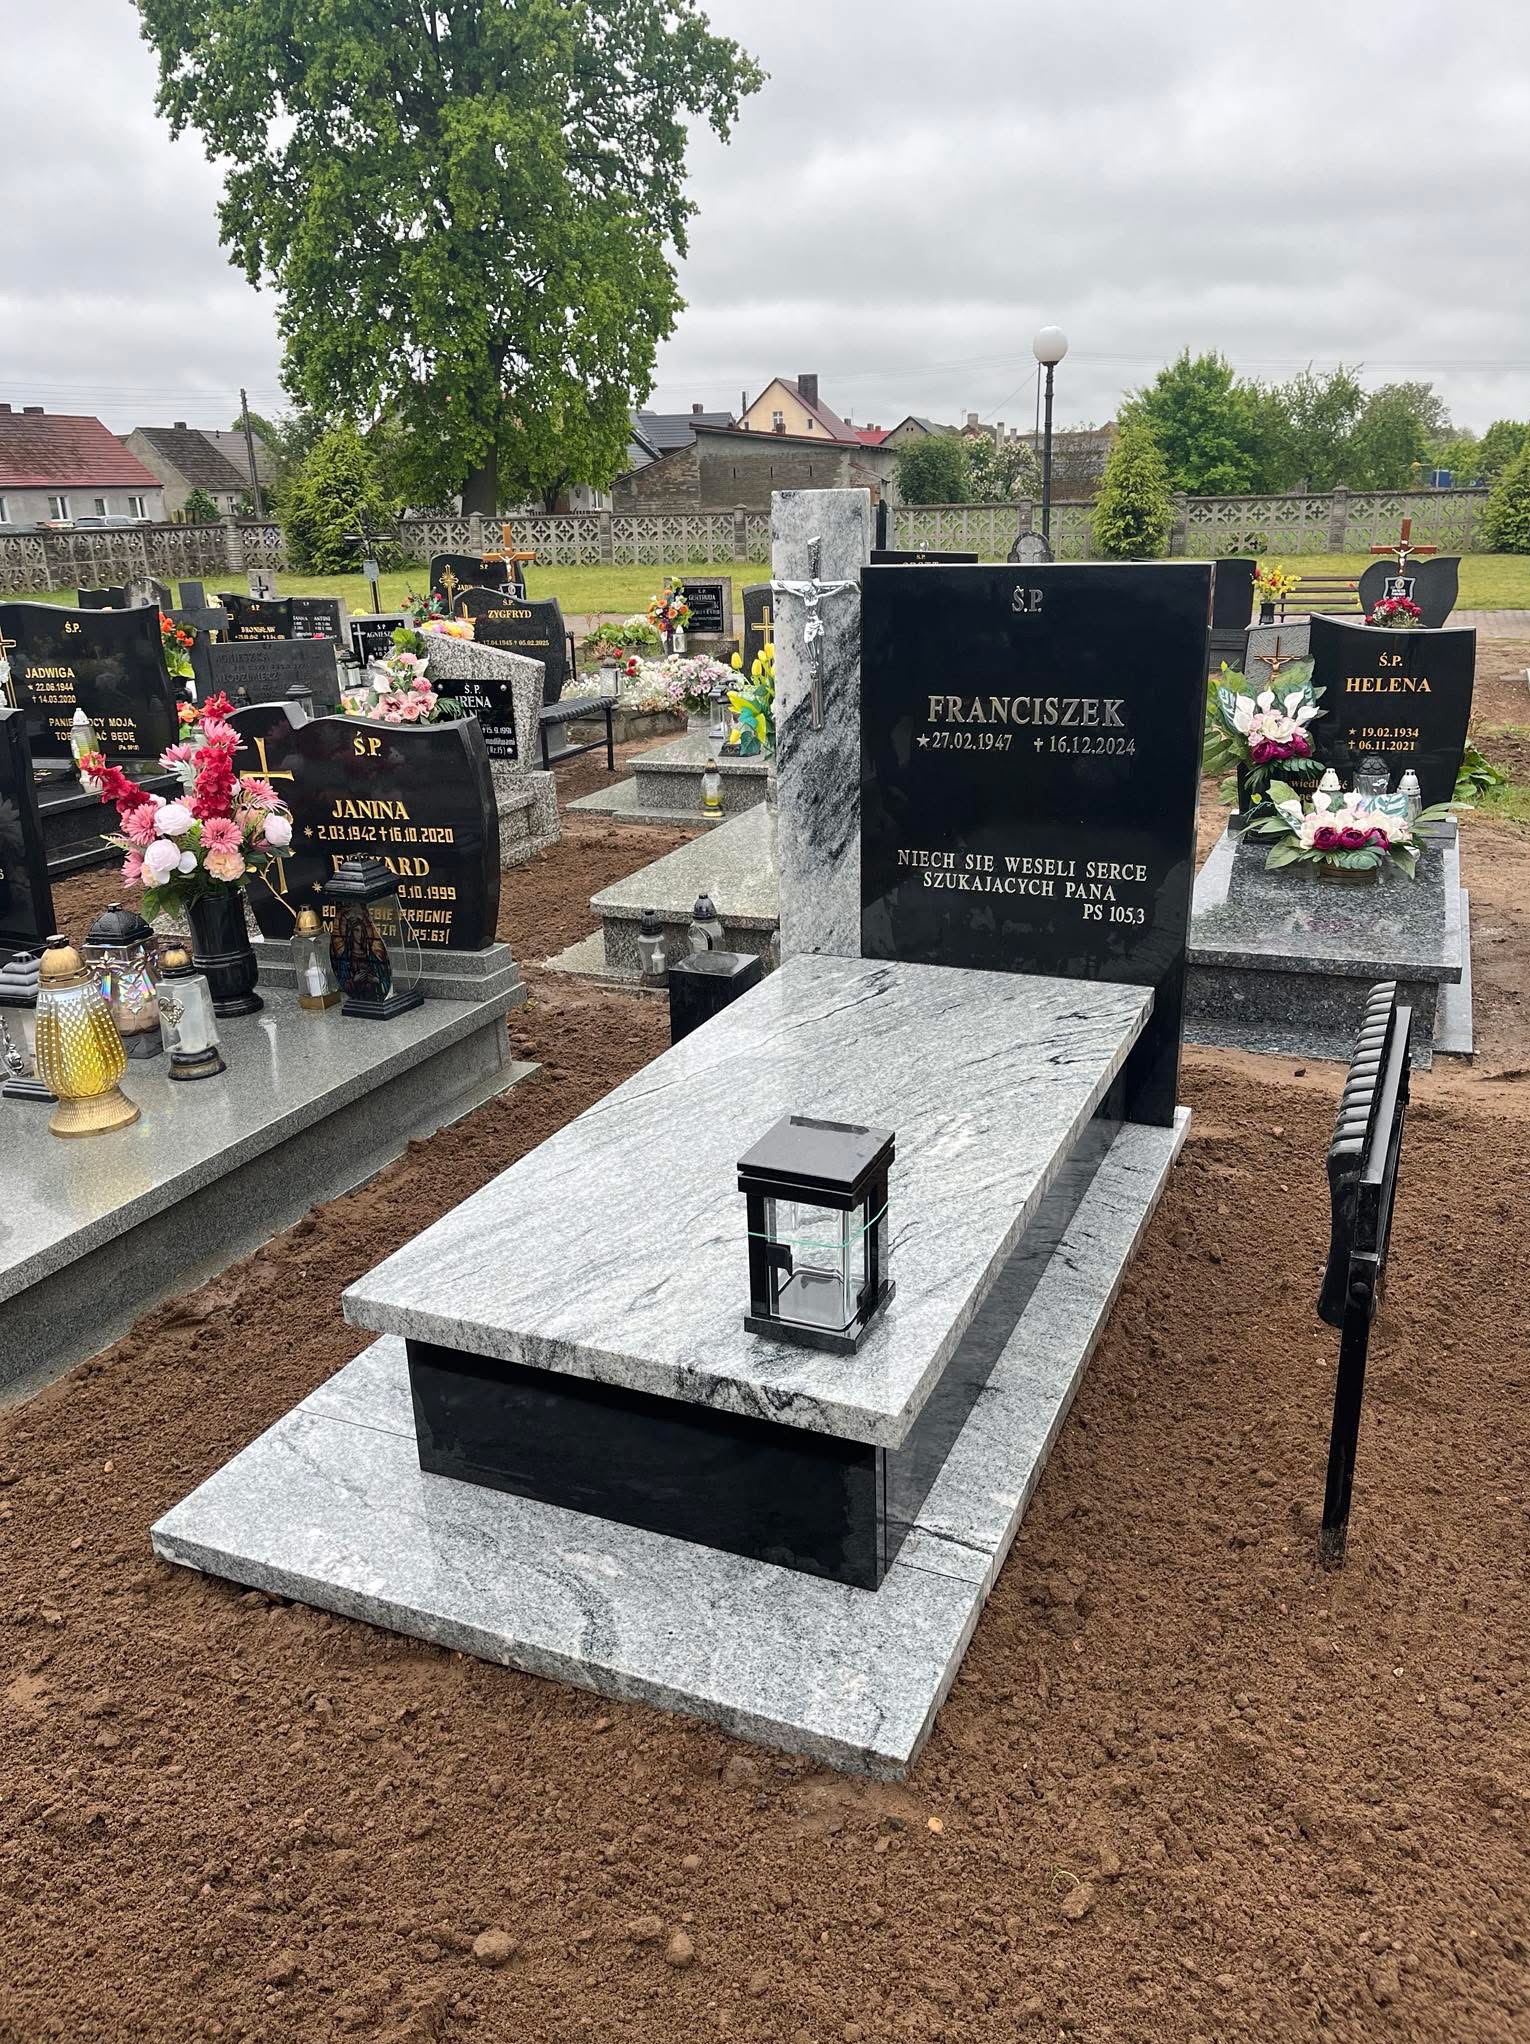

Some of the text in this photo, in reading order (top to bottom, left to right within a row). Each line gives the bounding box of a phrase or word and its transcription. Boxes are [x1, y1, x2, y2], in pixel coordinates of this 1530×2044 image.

[487, 610, 532, 619] ZYGFRYD
[64, 621, 82, 633] Ś.P.
[1379, 651, 1403, 667] Ś.P.
[25, 667, 75, 679] JADWIGA
[1345, 677, 1432, 693] HELENA
[927, 695, 1126, 727] FRANCISZEK
[108, 718, 137, 728] MOJA,
[111, 732, 136, 743] BĘDĘ
[1361, 727, 1419, 738] 19.02.1934
[353, 731, 382, 757] Ś.P.
[931, 731, 1136, 756] 27.02.1947 16.12.2024
[1359, 741, 1415, 751] 06.11.2021
[332, 799, 410, 820] JANINA
[317, 825, 454, 843] 2.03.1942 16.10.2020
[331, 854, 430, 877] EARD
[898, 850, 955, 868] NIECH
[1005, 857, 1075, 877] WESELI
[1086, 862, 1147, 882] SERCE
[1065, 882, 1116, 901] PANA
[1083, 903, 1145, 924] PS 105,3
